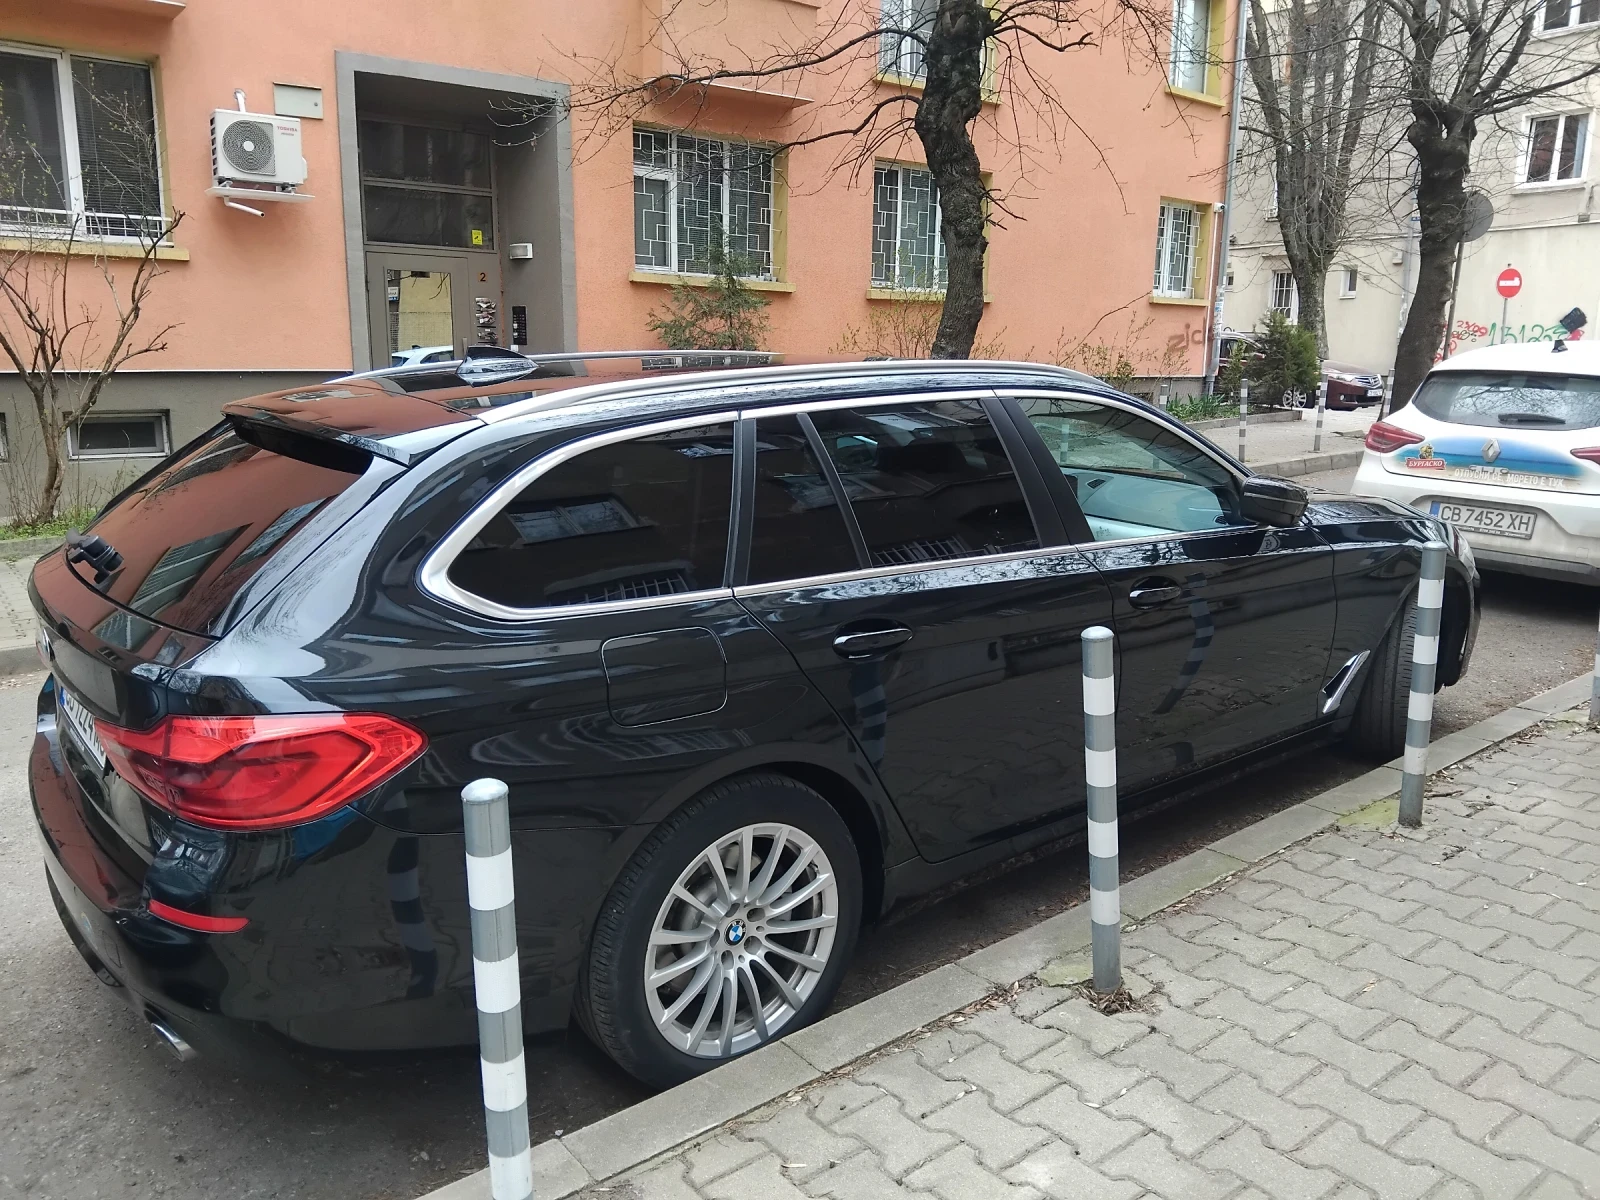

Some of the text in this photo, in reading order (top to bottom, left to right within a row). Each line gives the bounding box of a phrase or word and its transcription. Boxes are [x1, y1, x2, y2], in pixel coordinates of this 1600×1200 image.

[480, 272, 486, 281] 2
[1454, 468, 1490, 480] ОТПУСНИ
[1506, 473, 1538, 485] МОРЕТО
[1440, 505, 1461, 522] CB
[1463, 508, 1505, 529] 7452
[1508, 513, 1531, 532] XH
